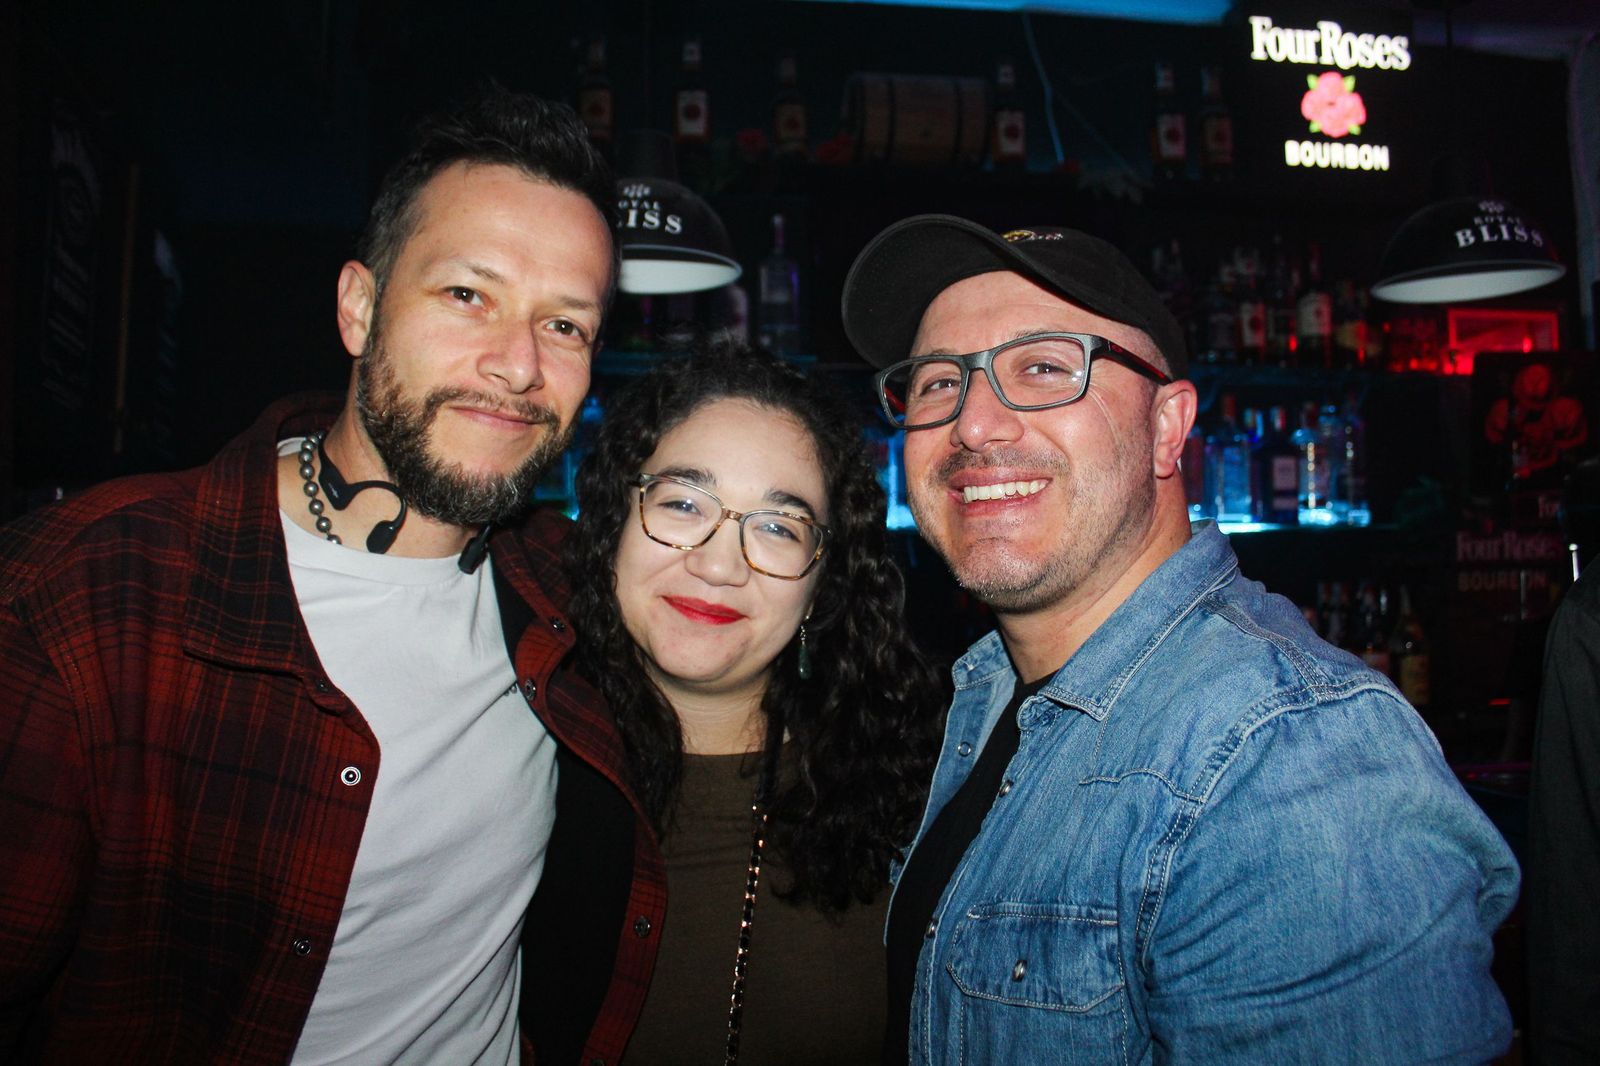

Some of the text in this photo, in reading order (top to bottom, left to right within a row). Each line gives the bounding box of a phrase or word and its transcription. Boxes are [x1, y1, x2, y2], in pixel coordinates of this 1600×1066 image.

[1284, 139, 1391, 172] BOURBON
[617, 199, 660, 210] OYAL
[1454, 222, 1544, 248] BLISS
